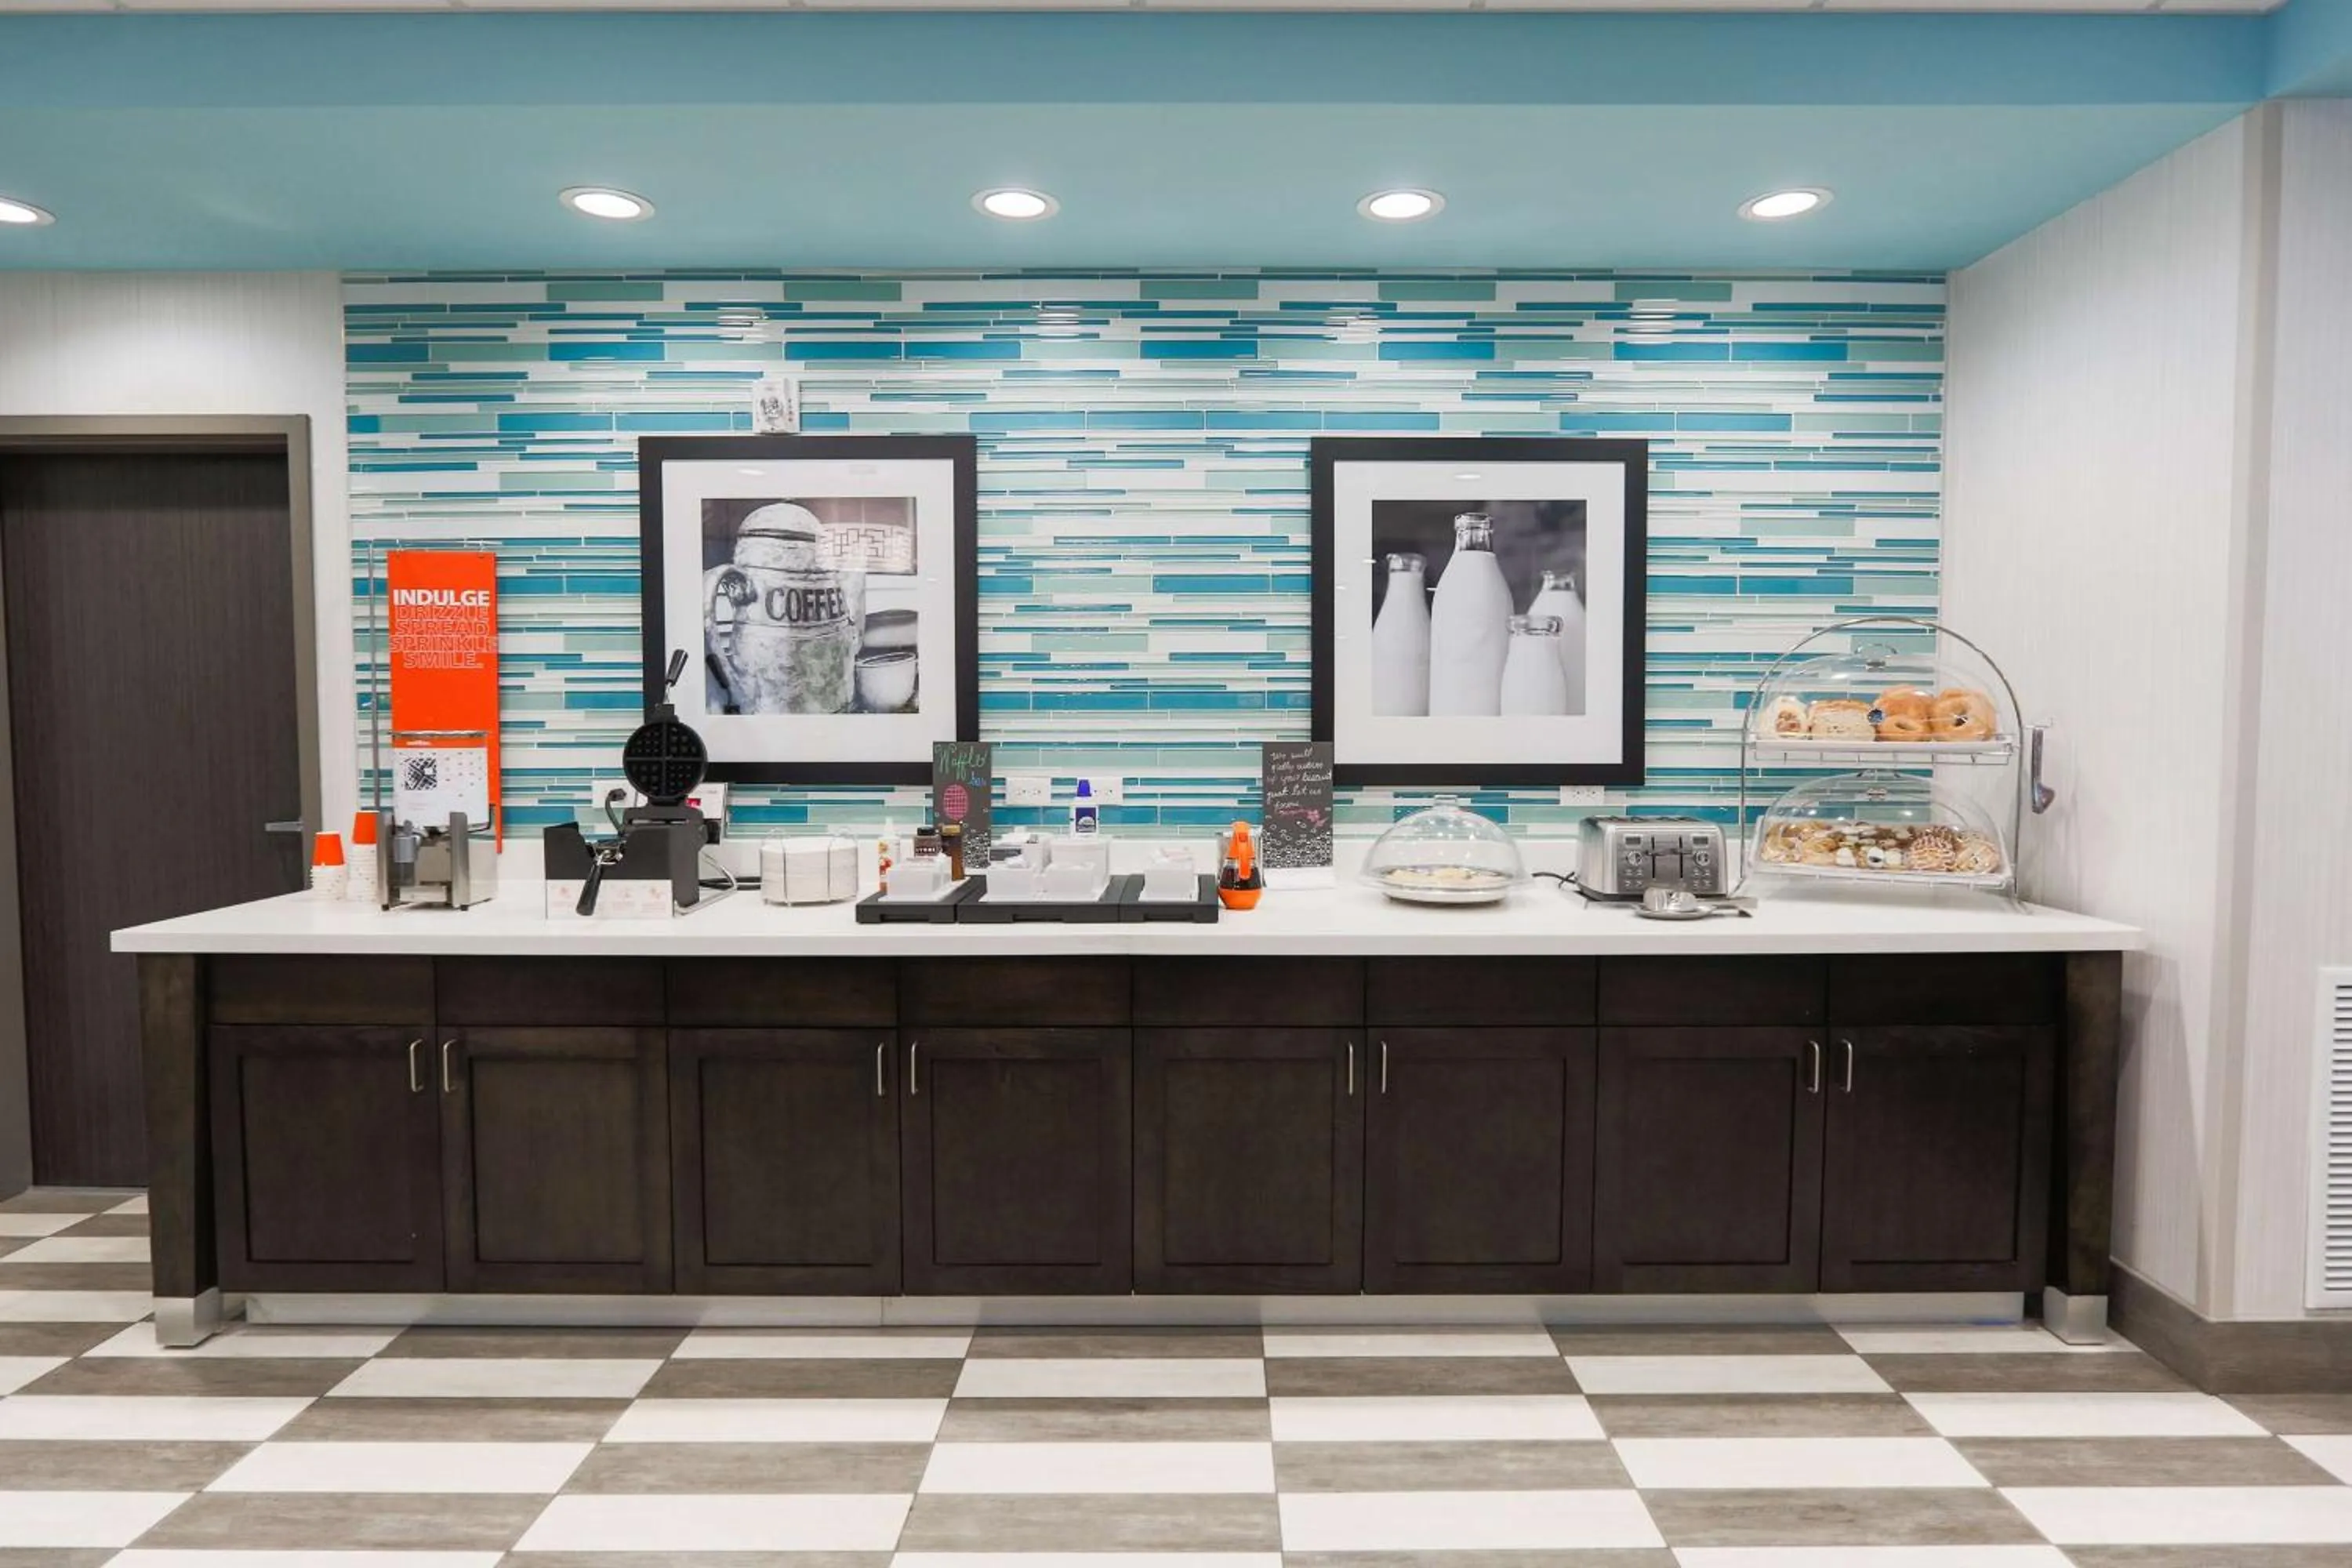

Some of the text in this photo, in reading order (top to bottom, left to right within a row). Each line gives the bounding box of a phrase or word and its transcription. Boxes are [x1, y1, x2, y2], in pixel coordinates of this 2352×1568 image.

[393, 589, 490, 606] INDULGE
[765, 587, 845, 622] COFFEE
[395, 605, 489, 621] DRIZZLE
[395, 620, 490, 636] SPREAD
[390, 636, 499, 652] SPRINKLE
